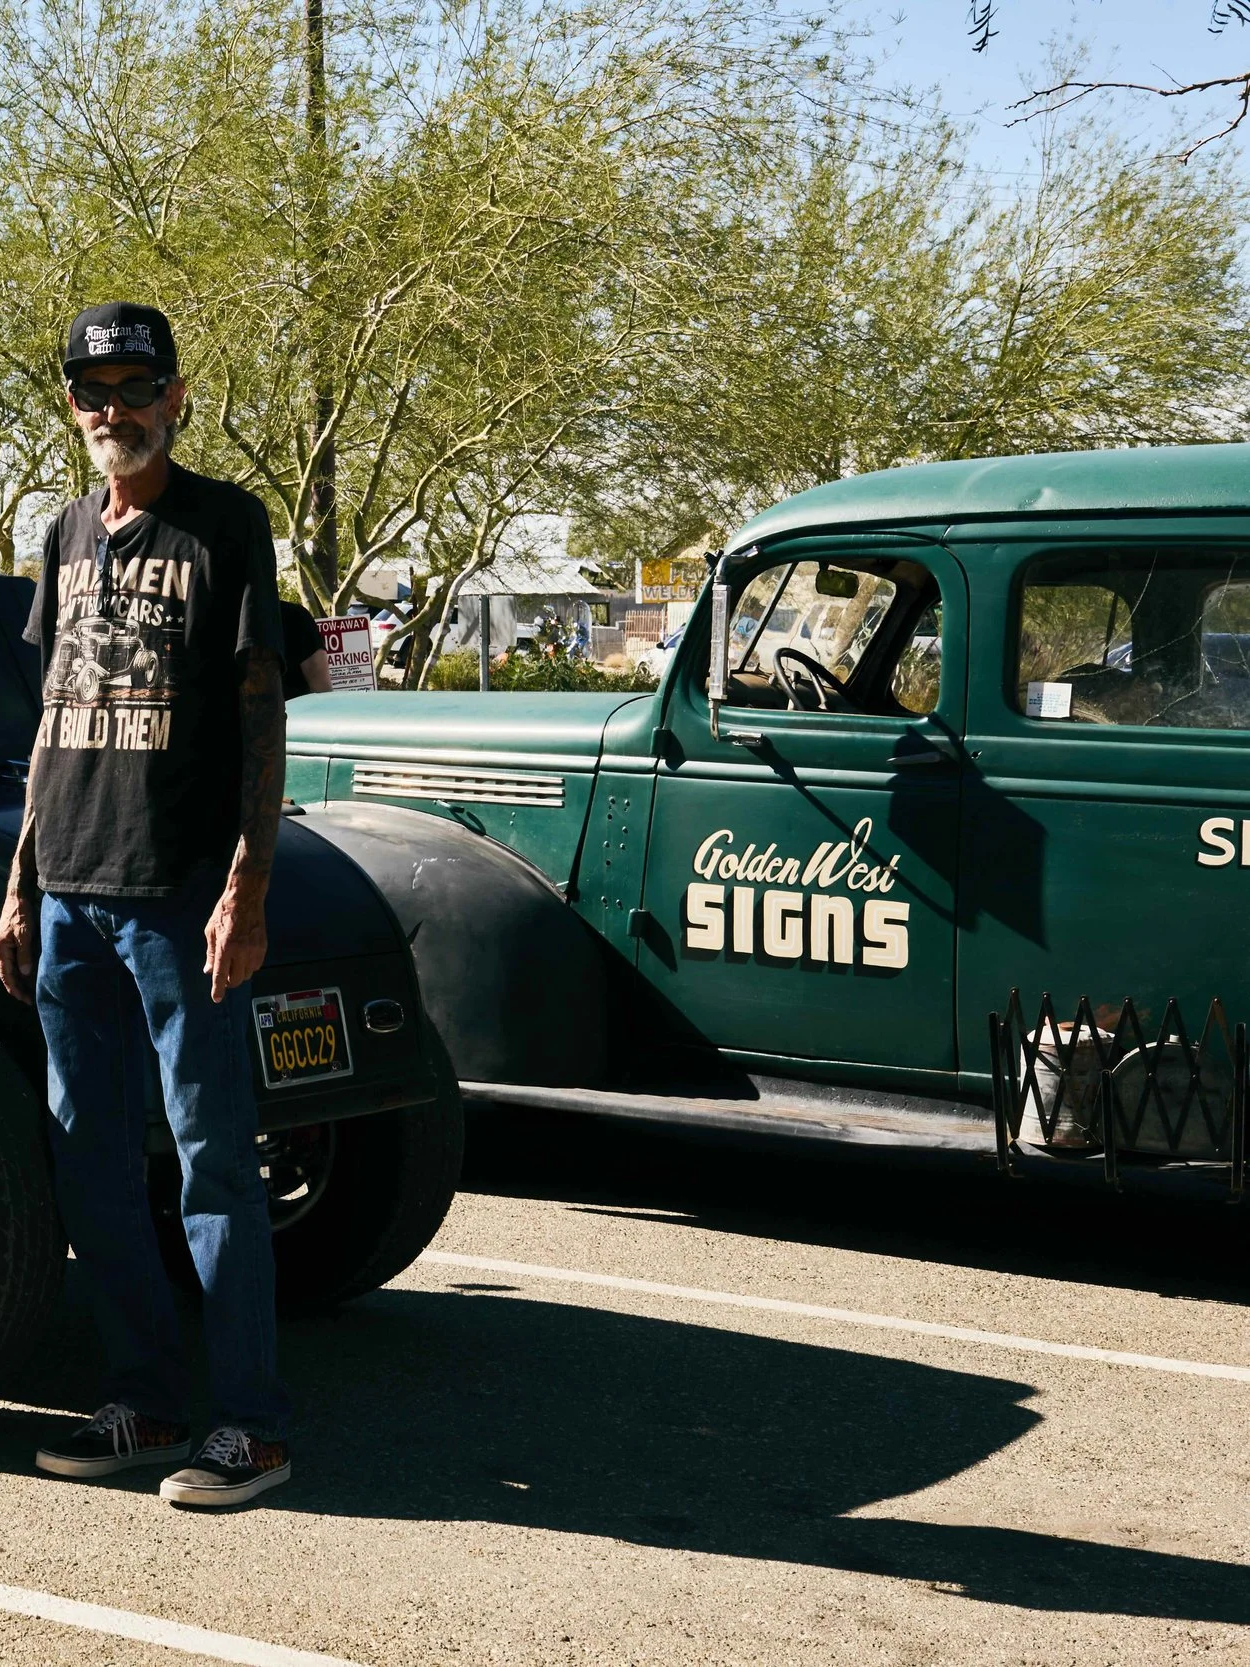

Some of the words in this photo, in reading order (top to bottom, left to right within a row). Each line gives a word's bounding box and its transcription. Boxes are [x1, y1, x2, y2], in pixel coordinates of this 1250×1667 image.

[84, 320, 132, 342] American
[134, 323, 152, 341] Art
[88, 339, 121, 355] Tattoo
[123, 338, 156, 356] Studio
[112, 558, 192, 602] MEN
[643, 585, 696, 600] WELD
[117, 595, 164, 628] CARS
[316, 618, 366, 633] TOW-AWAY
[326, 651, 370, 667] ARKING
[59, 707, 108, 749] BUILD
[114, 709, 172, 751] THEM
[693, 829, 801, 886] Golden
[801, 817, 901, 893] West
[686, 882, 910, 969] SIGNS
[260, 1014, 273, 1028] APR
[276, 1006, 323, 1023] CALIFORNIA
[270, 1024, 336, 1071] GGCC29
